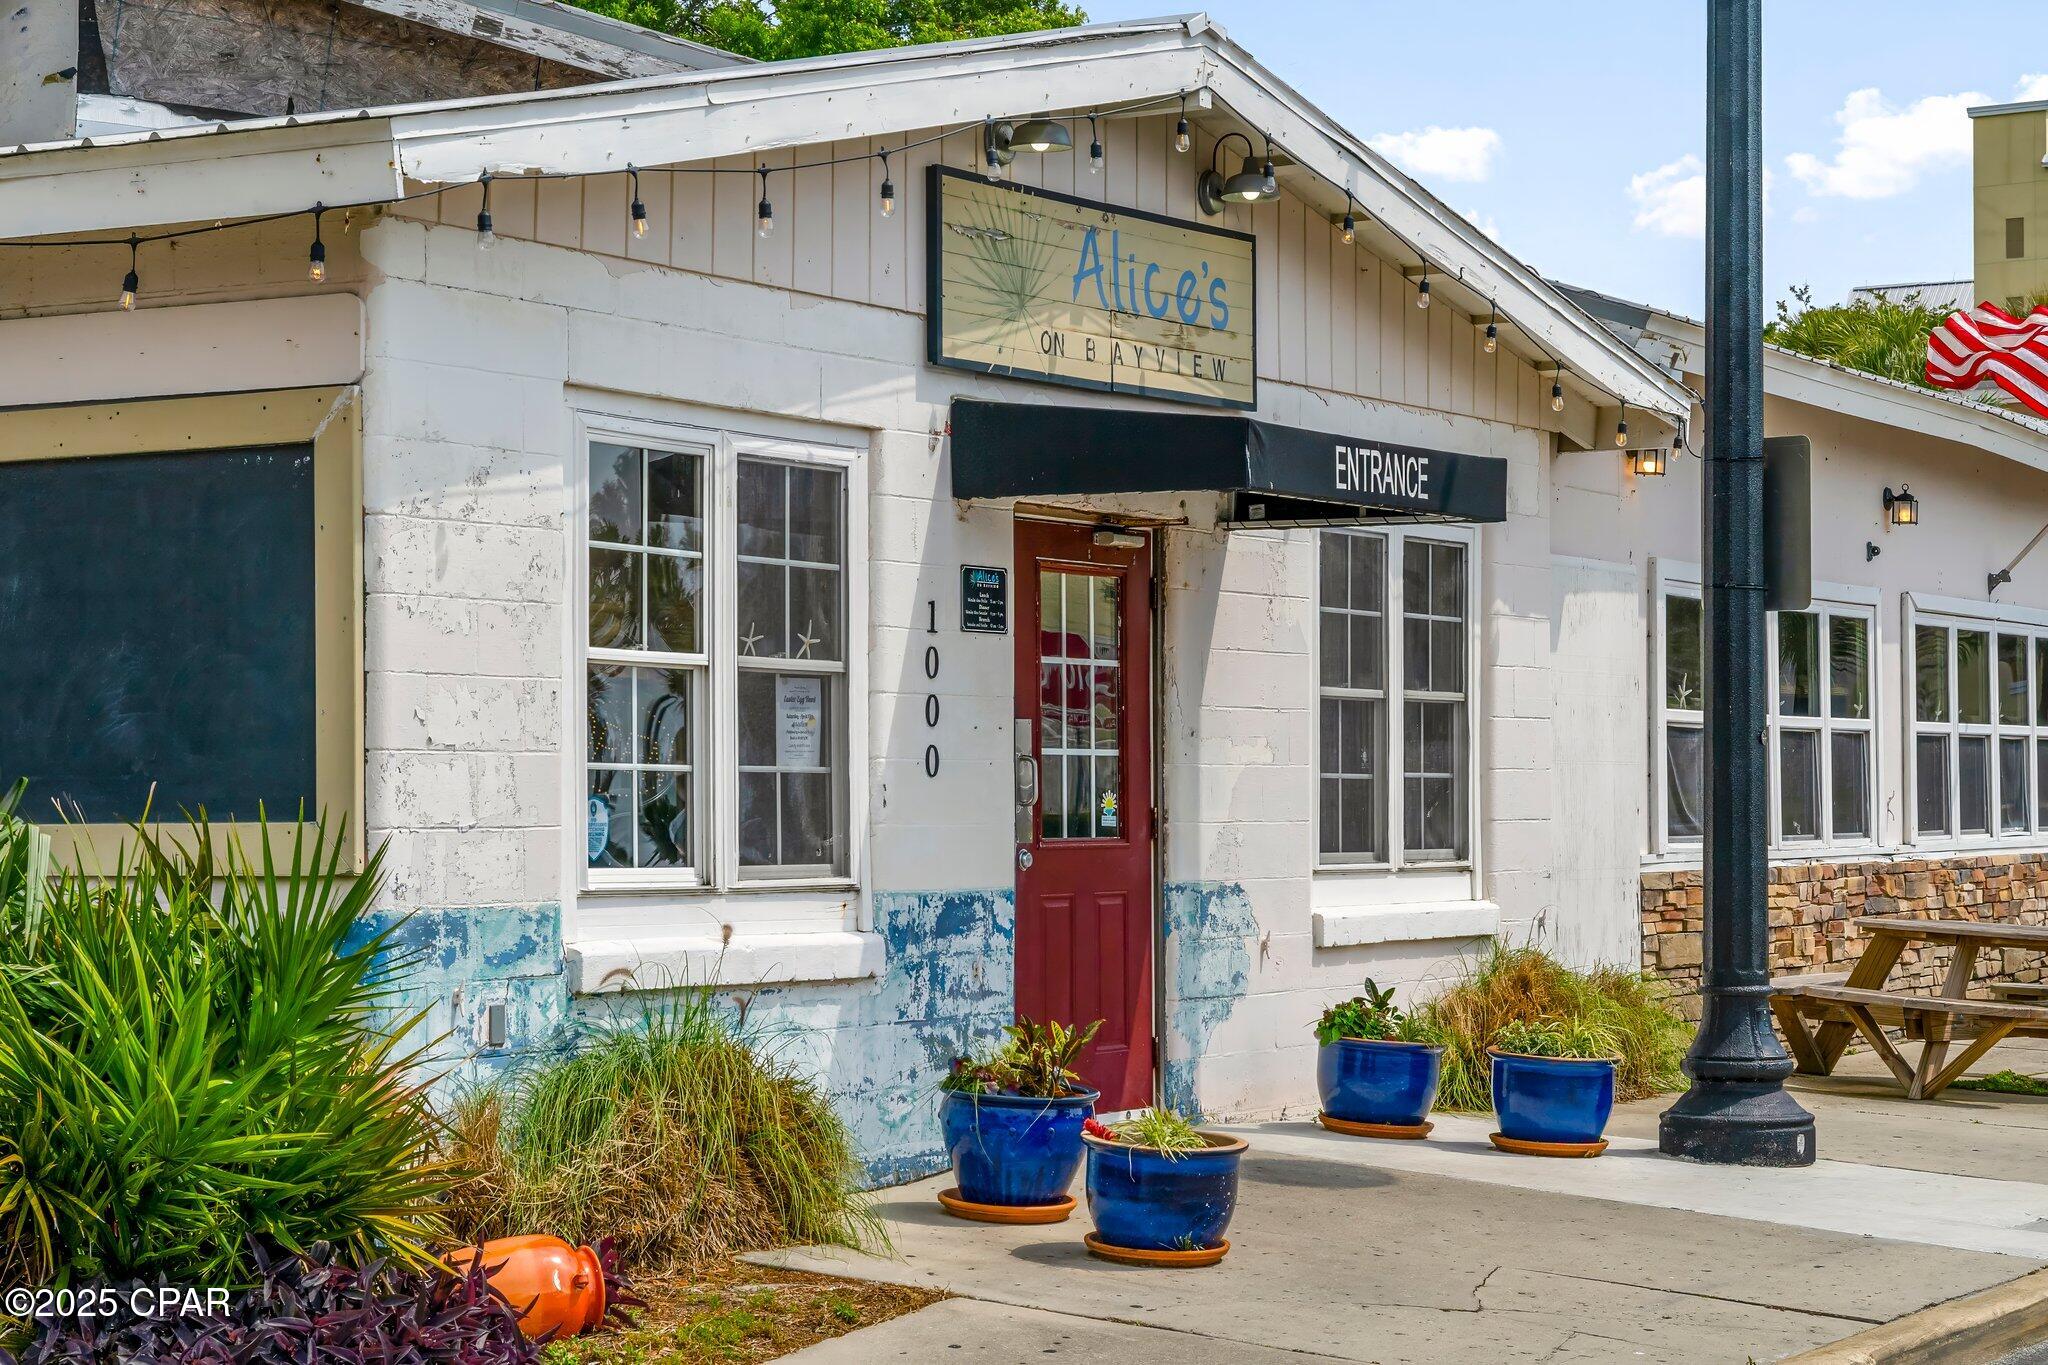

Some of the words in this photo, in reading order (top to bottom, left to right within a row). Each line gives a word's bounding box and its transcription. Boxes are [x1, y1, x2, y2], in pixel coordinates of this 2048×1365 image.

[1073, 224, 1229, 330] Alice's
[1040, 330, 1065, 357] ON
[1085, 337, 1226, 382] BAYVIEW
[1335, 445, 1429, 500] ENTRANCE
